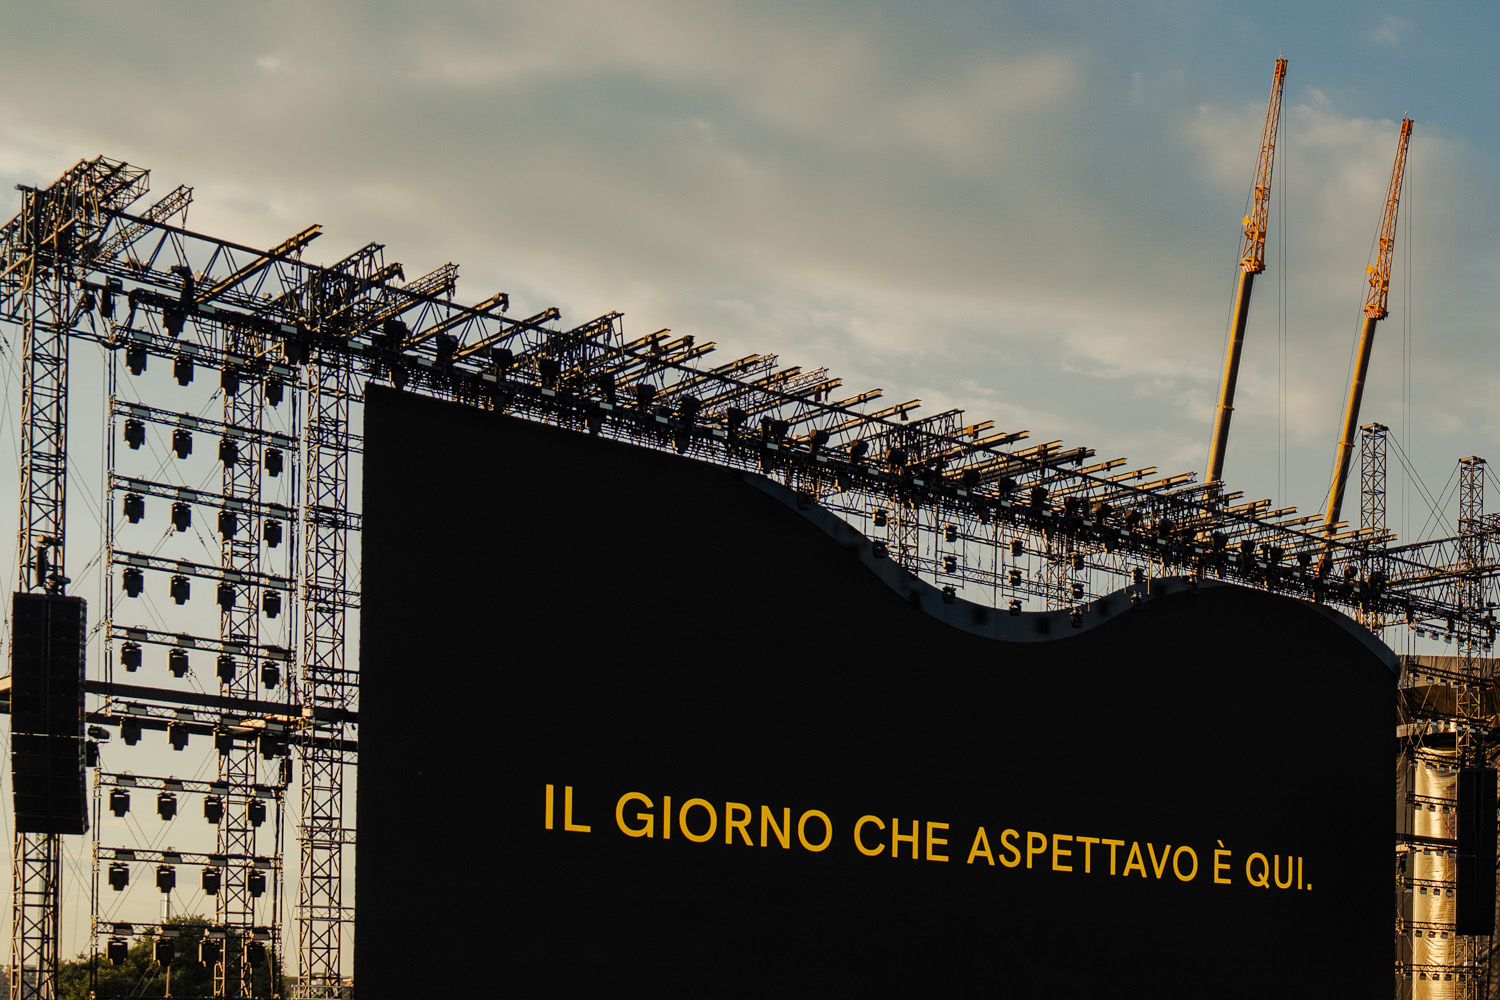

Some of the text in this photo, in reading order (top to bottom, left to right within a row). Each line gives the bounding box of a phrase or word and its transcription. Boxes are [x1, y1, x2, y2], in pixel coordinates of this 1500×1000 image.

[544, 783, 1313, 891] IL GIORNO CHE ASPETTAVO È QUI.
